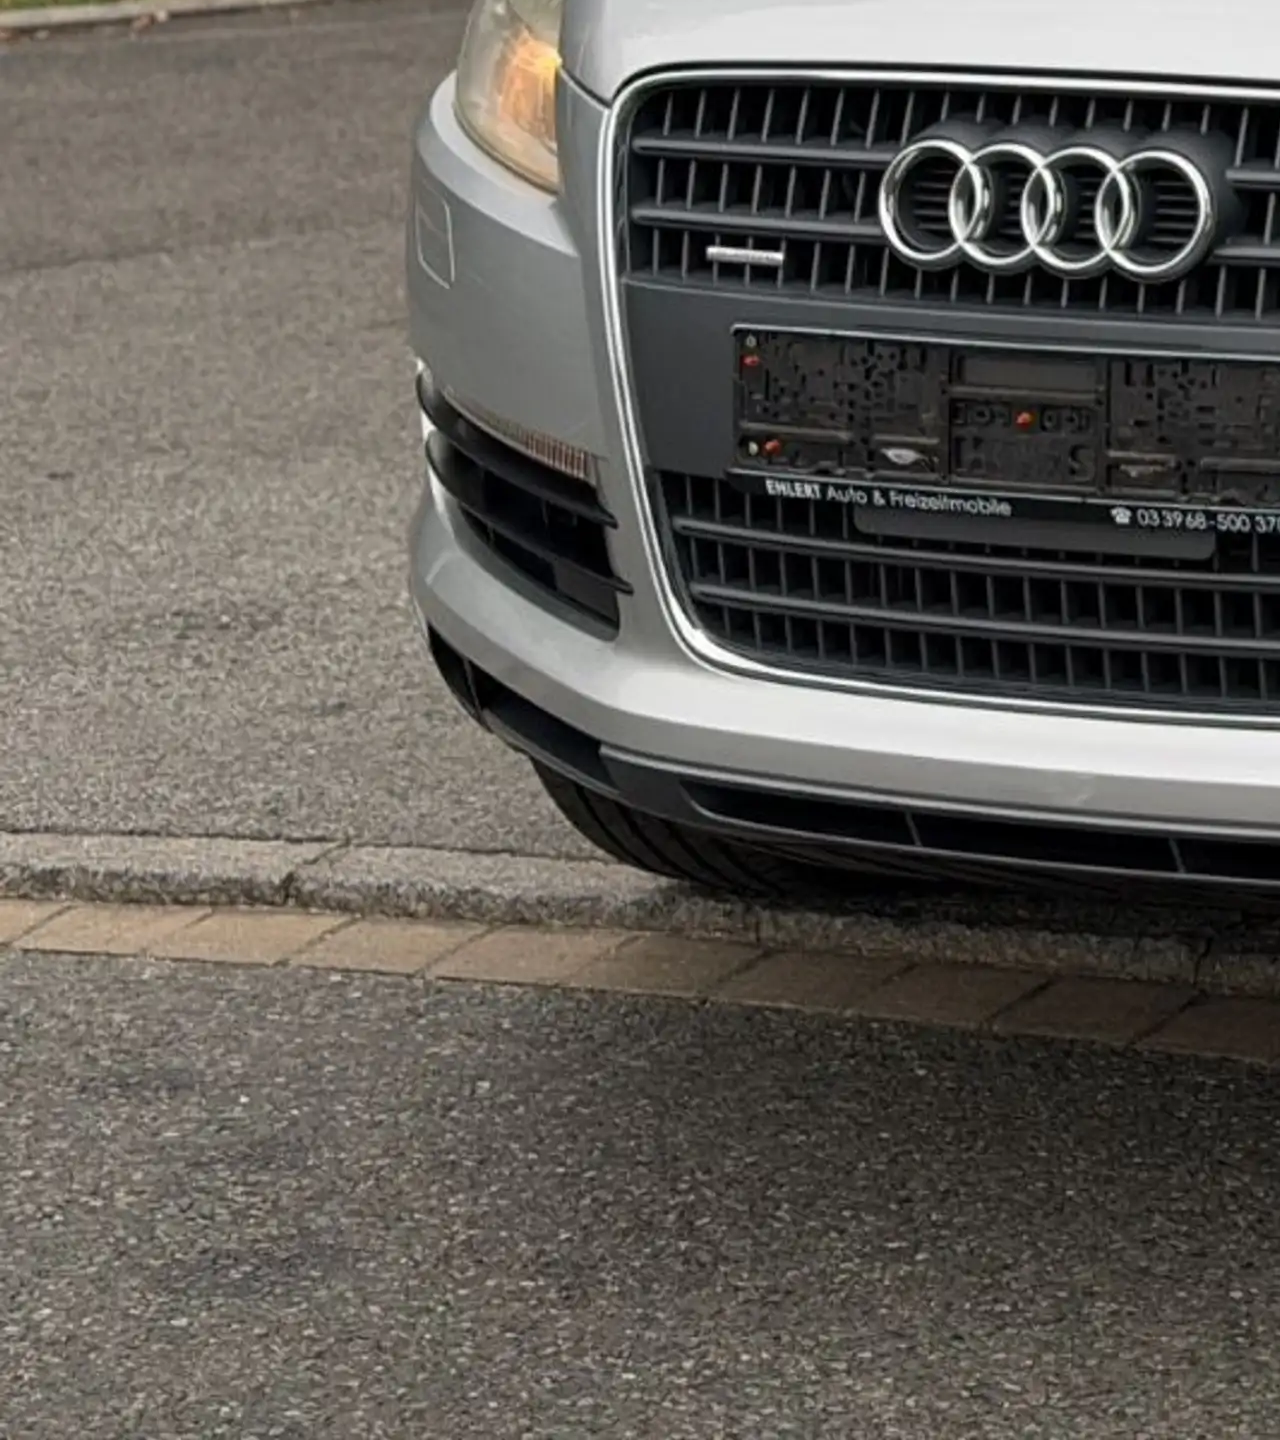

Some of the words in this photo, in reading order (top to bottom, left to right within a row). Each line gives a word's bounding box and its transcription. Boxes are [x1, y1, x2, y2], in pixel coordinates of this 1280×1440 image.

[827, 486, 868, 506] Auto
[873, 490, 886, 506] &
[890, 492, 1012, 517] Freizeitmobile
